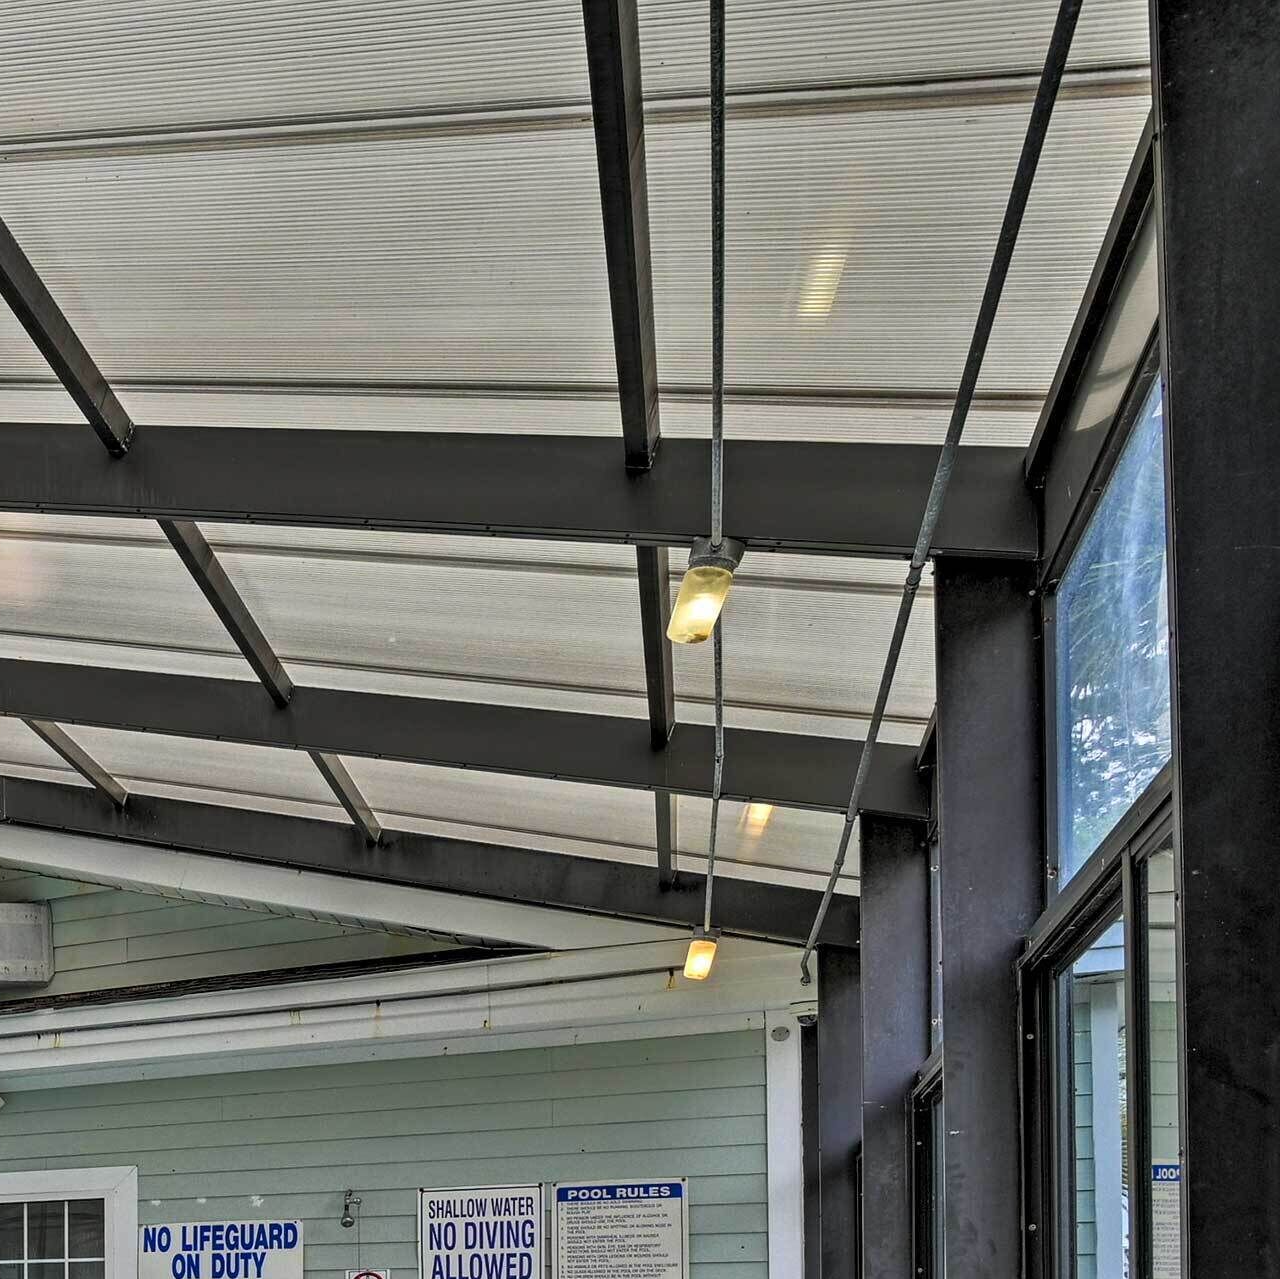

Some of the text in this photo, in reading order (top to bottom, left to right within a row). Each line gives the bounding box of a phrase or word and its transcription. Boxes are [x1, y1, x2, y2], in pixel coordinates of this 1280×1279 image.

[568, 1186, 670, 1200] POOL RULES
[428, 1196, 534, 1219] SHALLOW WATER
[143, 1223, 298, 1252] NO LIFEGUARD
[429, 1220, 535, 1250] NO DIVING
[172, 1252, 266, 1279] ON DUTY
